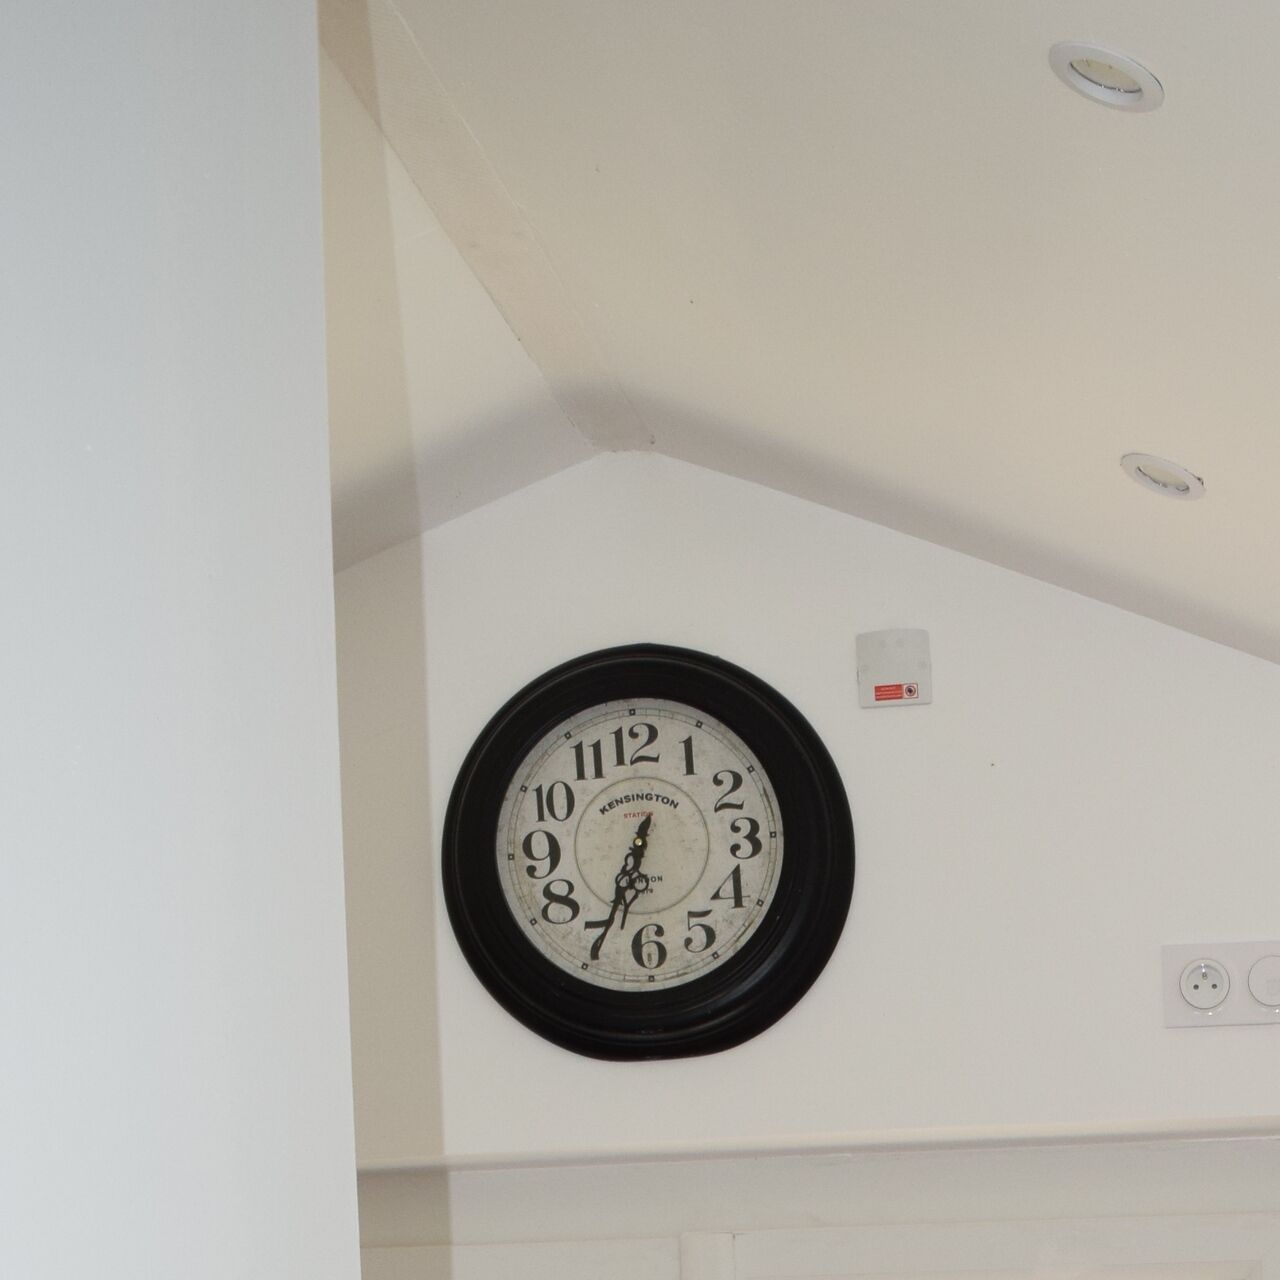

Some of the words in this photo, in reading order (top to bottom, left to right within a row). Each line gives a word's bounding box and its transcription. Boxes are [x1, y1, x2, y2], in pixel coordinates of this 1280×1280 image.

[570, 738, 606, 781] 11
[609, 722, 660, 767] 12
[678, 735, 698, 776] 1
[533, 780, 575, 823] 10
[599, 792, 679, 815] KENSINGTON
[712, 769, 745, 813] 2
[522, 829, 561, 879] 9
[729, 817, 762, 859] 3
[541, 878, 580, 924] 8
[710, 863, 751, 909] 4
[584, 917, 614, 960] 7
[631, 923, 667, 969] 6
[684, 909, 716, 953] 5
